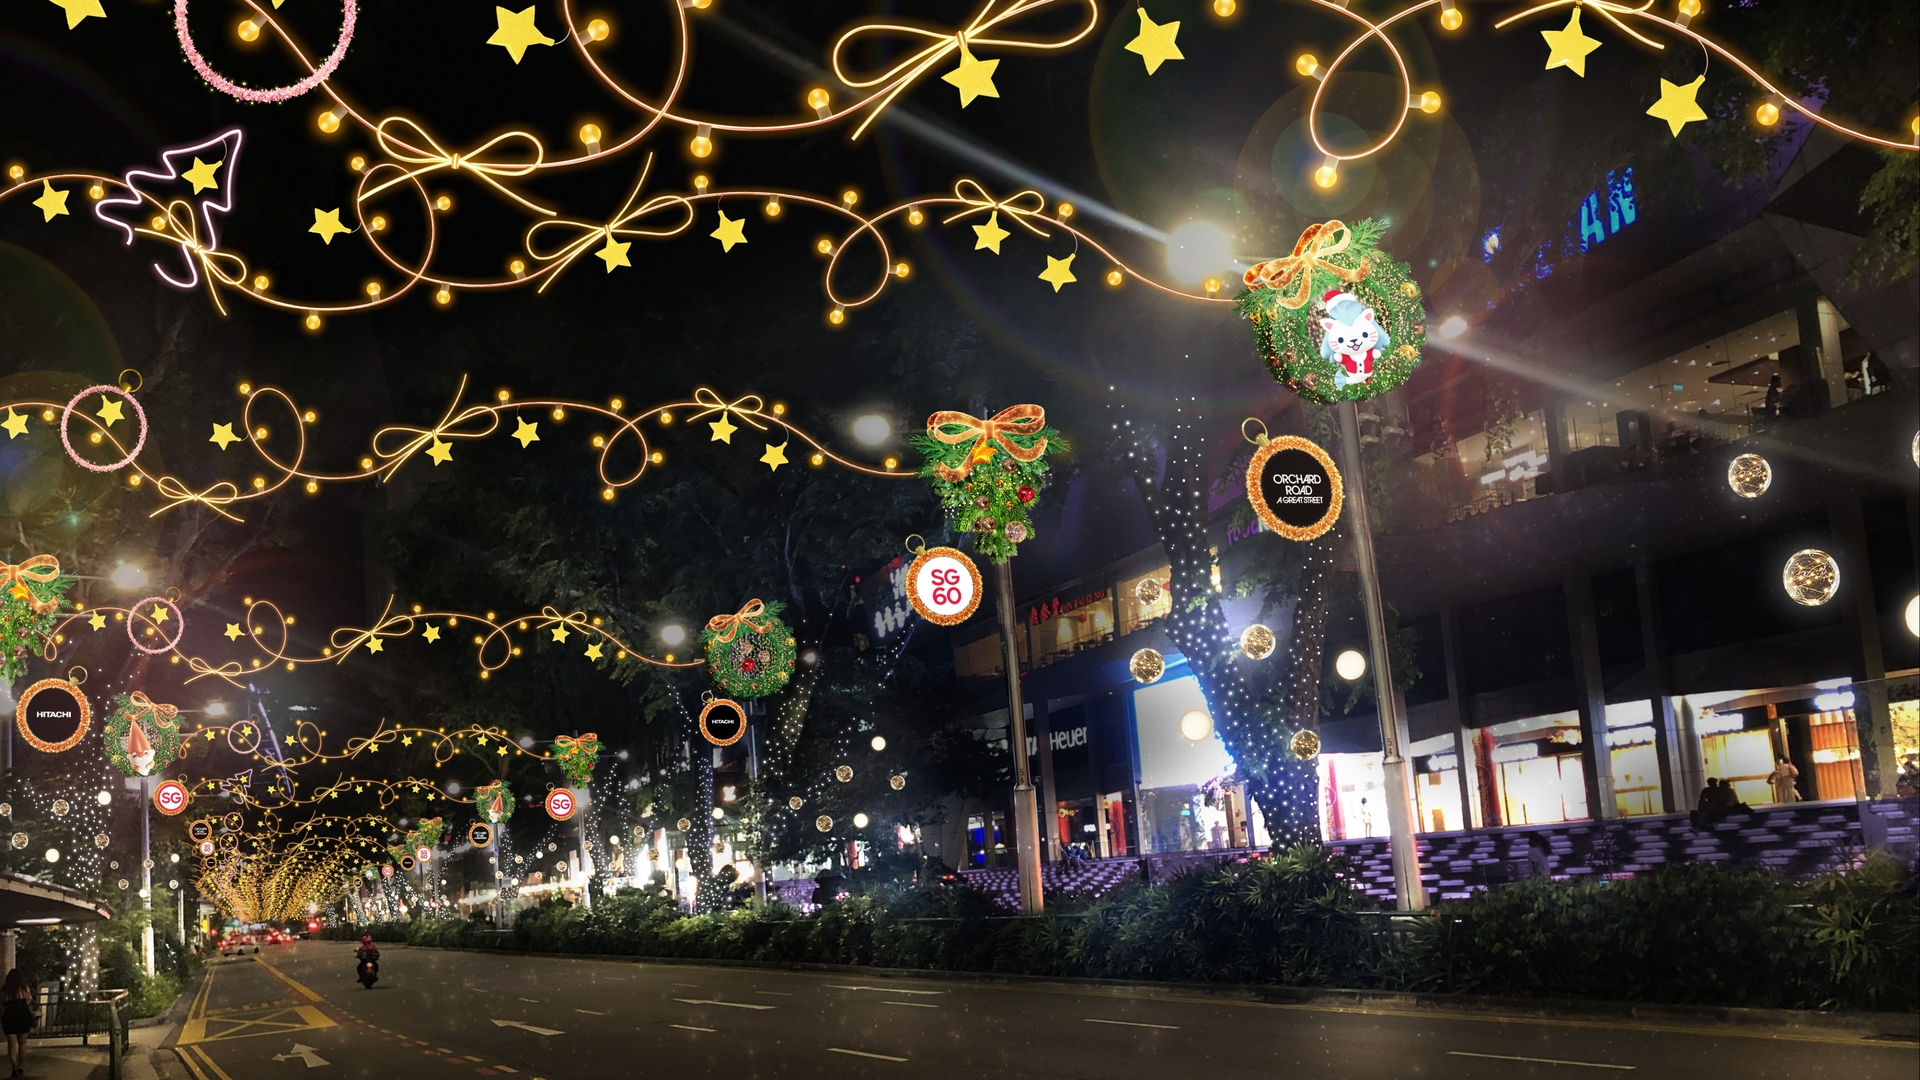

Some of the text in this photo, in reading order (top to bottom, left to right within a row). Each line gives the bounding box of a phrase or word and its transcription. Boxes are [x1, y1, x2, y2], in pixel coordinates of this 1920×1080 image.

[1272, 474, 1322, 484] ORCHARD
[1285, 485, 1313, 495] ROAD
[1276, 496, 1323, 504] A GREAT STREET
[930, 568, 961, 586] SG
[932, 586, 962, 606] 60
[1049, 726, 1087, 751] Heuer
[161, 792, 182, 804] SG
[552, 799, 570, 810] SG
